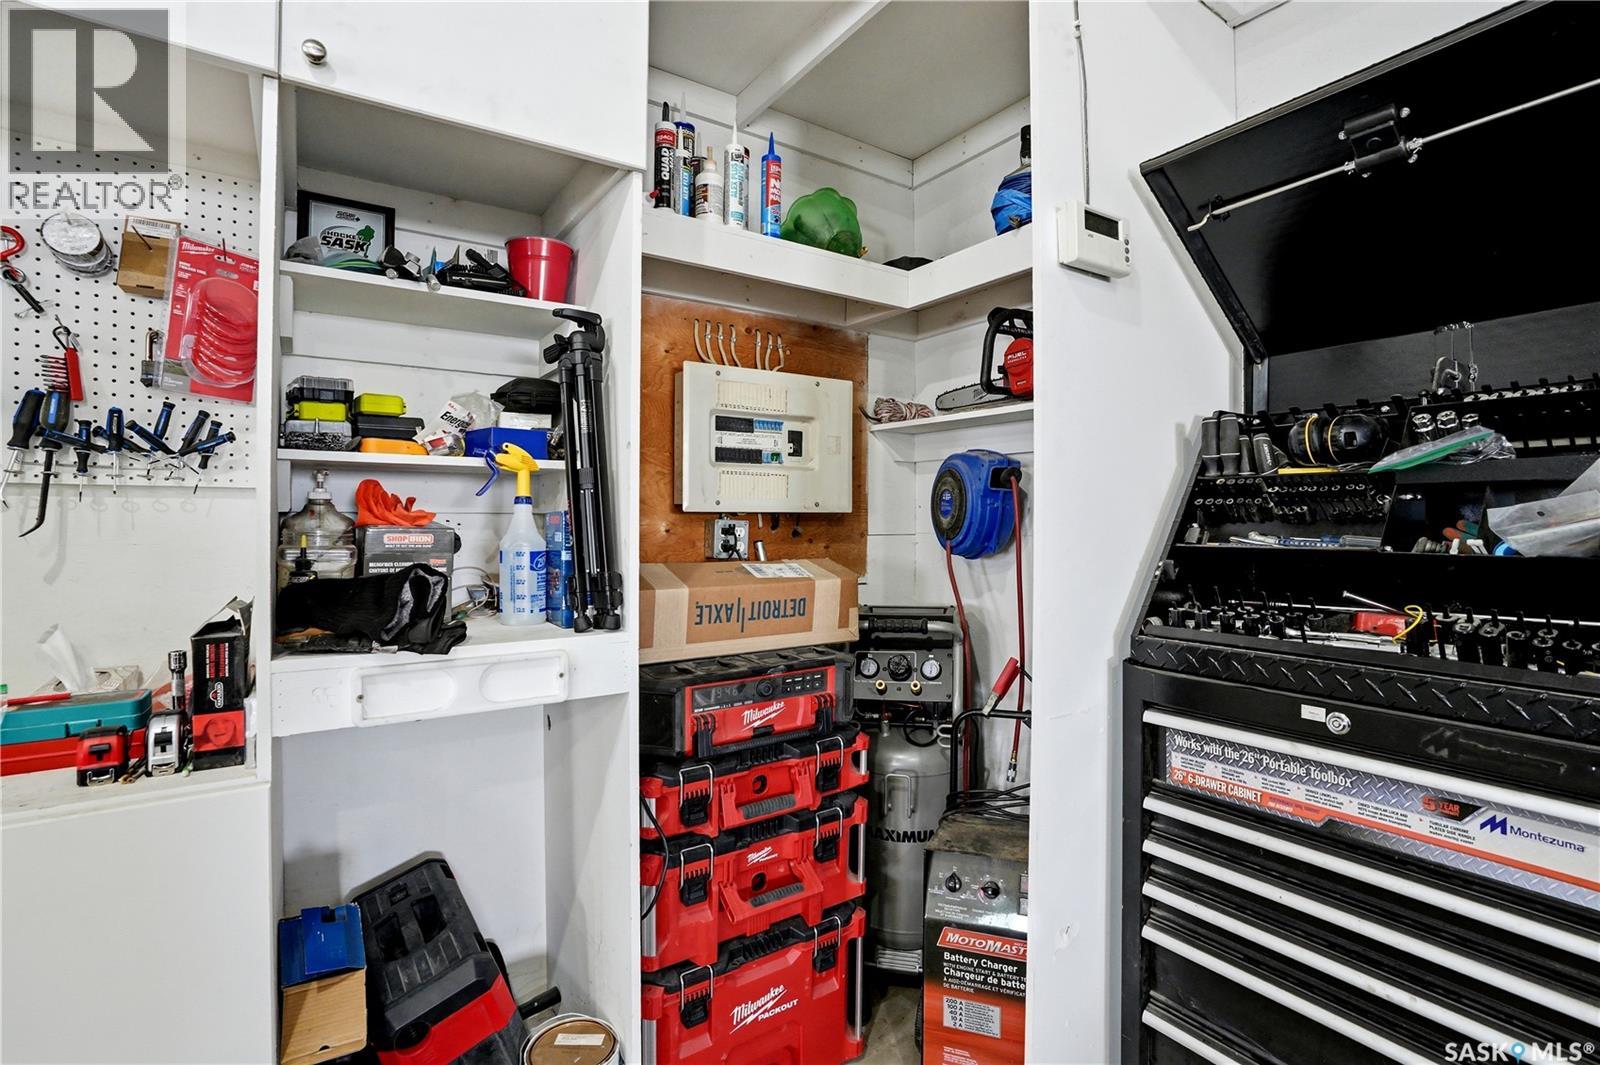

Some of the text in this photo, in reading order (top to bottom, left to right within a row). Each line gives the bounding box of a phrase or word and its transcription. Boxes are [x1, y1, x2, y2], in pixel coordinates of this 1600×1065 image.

[661, 148, 670, 180] QUAD
[320, 236, 367, 252] SASK
[694, 598, 806, 625] DETROIT AXLE
[742, 701, 785, 725] Milwaukee
[1173, 734, 1201, 751] Works
[1203, 742, 1222, 755] with
[1224, 746, 1240, 760] the
[1263, 755, 1307, 777] Portable
[1309, 765, 1352, 788] Toolbox
[1187, 773, 1227, 794] 6-DRAWER
[1228, 784, 1262, 803] CABINET
[1510, 825, 1585, 853] Montezuma
[946, 932, 1027, 955] MOTOMAST
[943, 951, 1018, 973] Battery Charger
[943, 967, 1027, 990] Chargeur de batte
[729, 984, 785, 1025] Milwaukee
[758, 998, 799, 1022] PACKOUT
